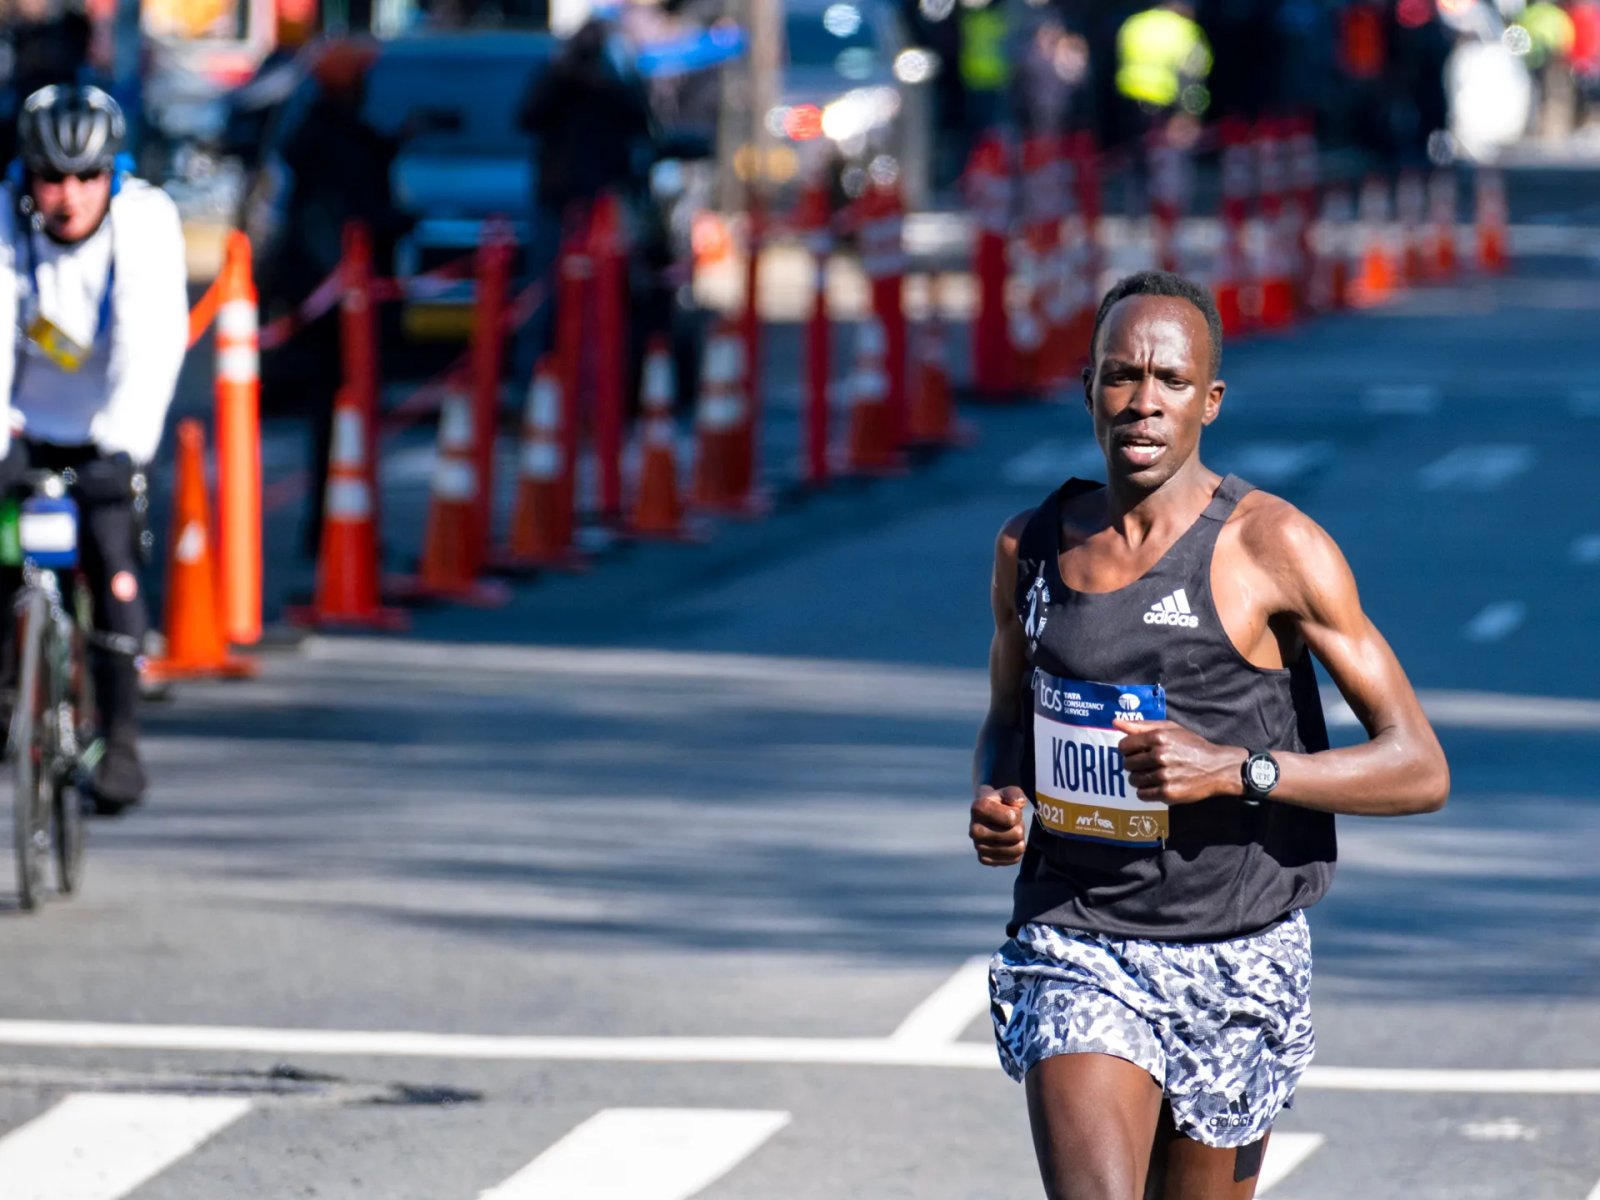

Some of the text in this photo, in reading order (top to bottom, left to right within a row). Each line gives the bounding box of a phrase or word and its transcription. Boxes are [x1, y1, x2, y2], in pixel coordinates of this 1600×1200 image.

[1143, 610, 1199, 628] adidas
[1063, 692, 1082, 701] TATA
[1063, 700, 1104, 711] CONSULTANCY
[1064, 707, 1090, 717] SERVICES
[1114, 711, 1145, 721] TATA
[1052, 736, 1126, 798] KORIR
[1209, 1113, 1254, 1128] adidas
